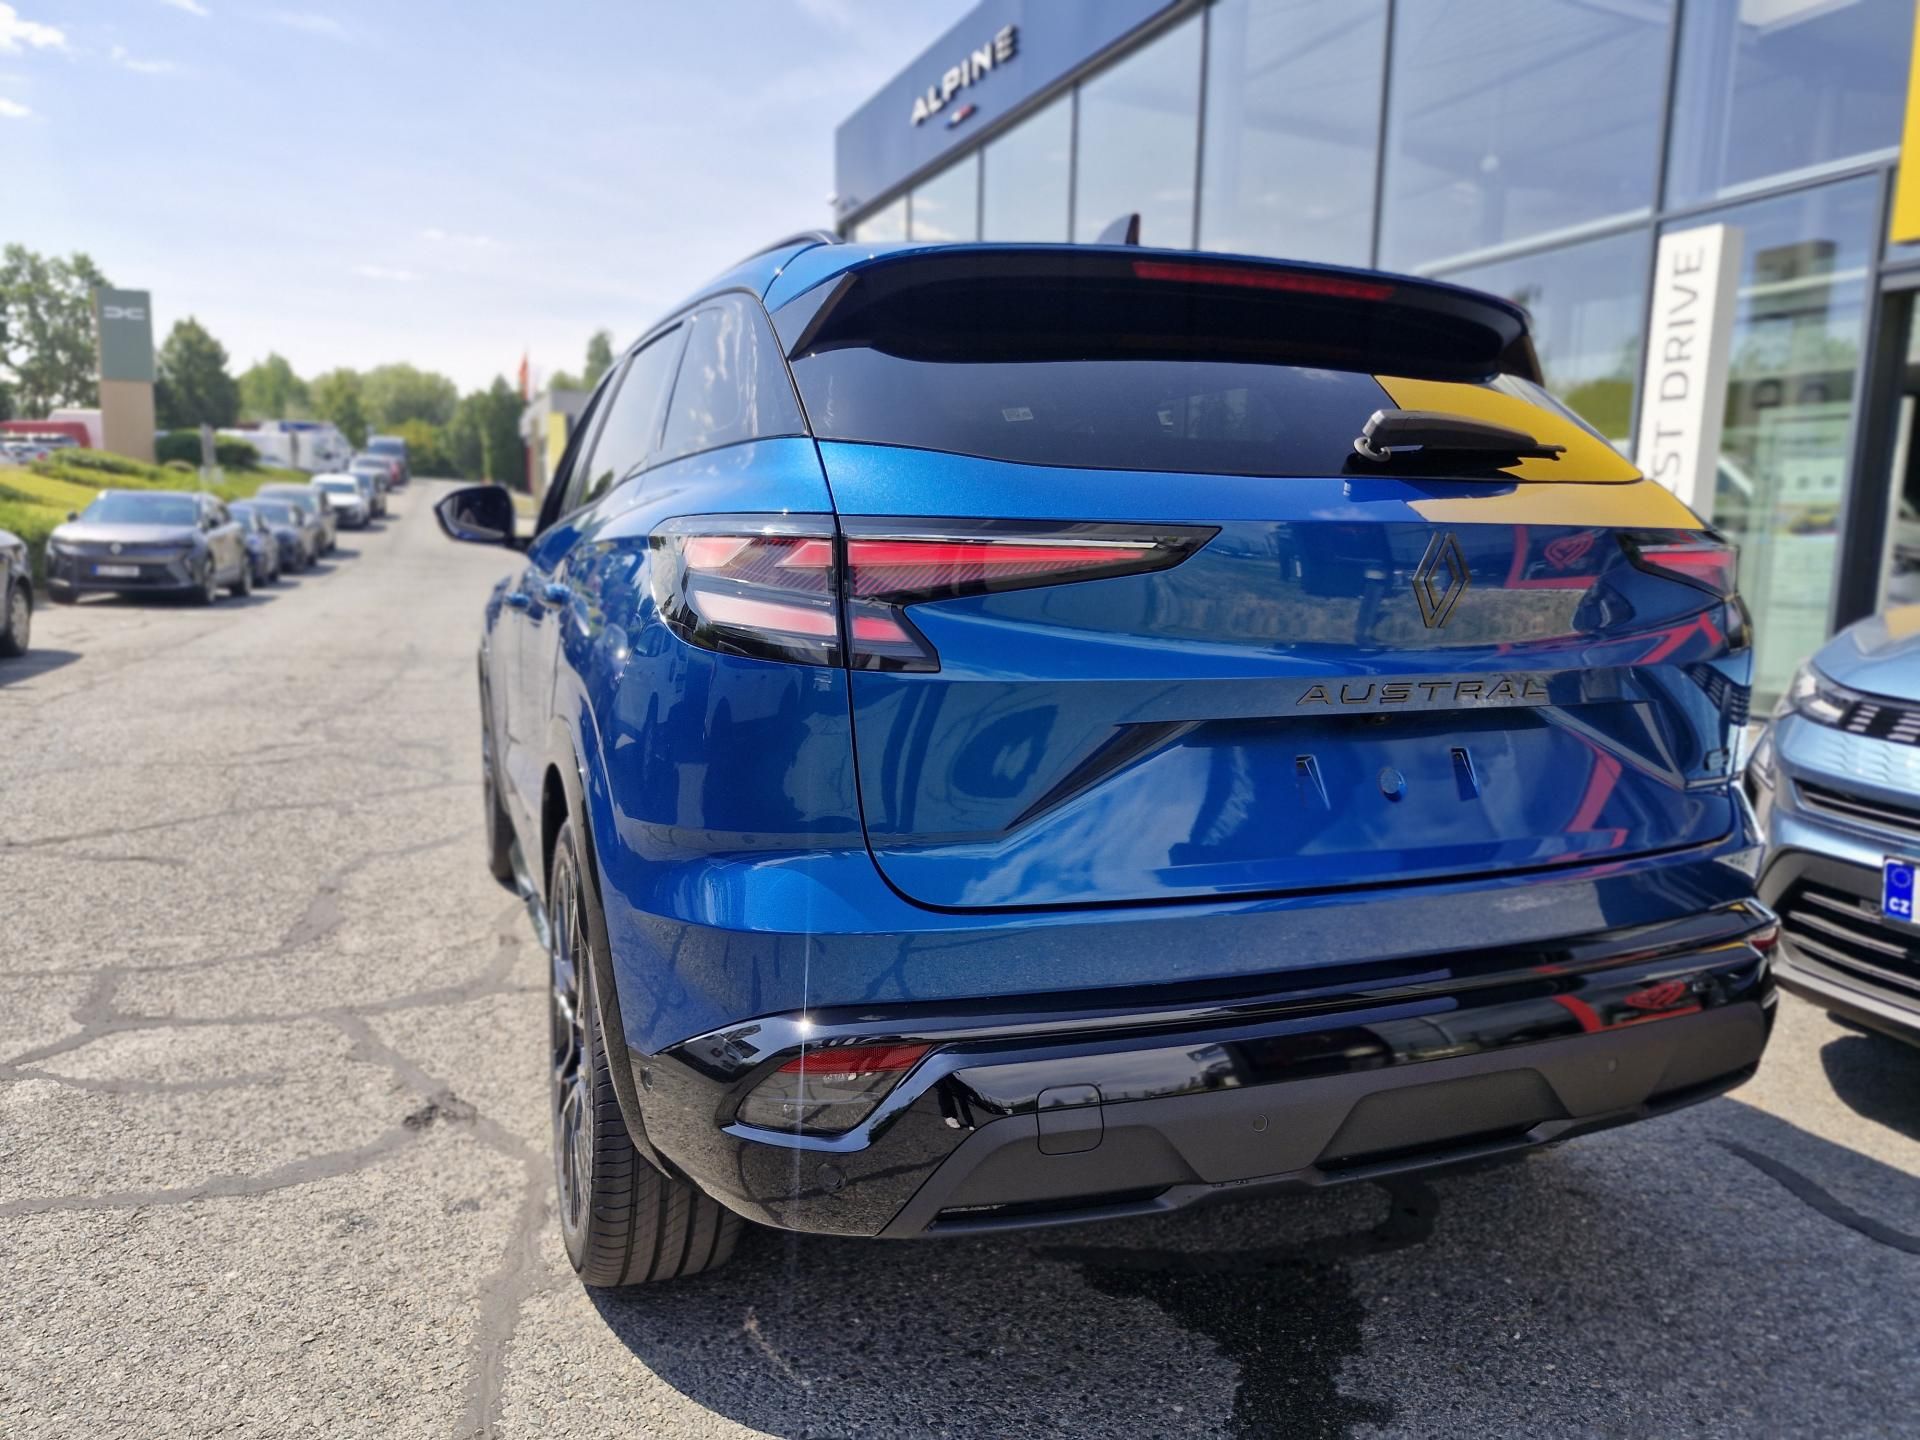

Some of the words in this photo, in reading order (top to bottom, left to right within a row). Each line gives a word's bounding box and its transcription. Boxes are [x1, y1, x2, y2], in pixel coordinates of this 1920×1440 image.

[910, 24, 1017, 126] ALPINE
[1659, 246, 1705, 403] DRIVE
[1651, 420, 1684, 494] ST
[1296, 679, 1550, 706] AUSTRAL
[1889, 897, 1910, 914] CZ
